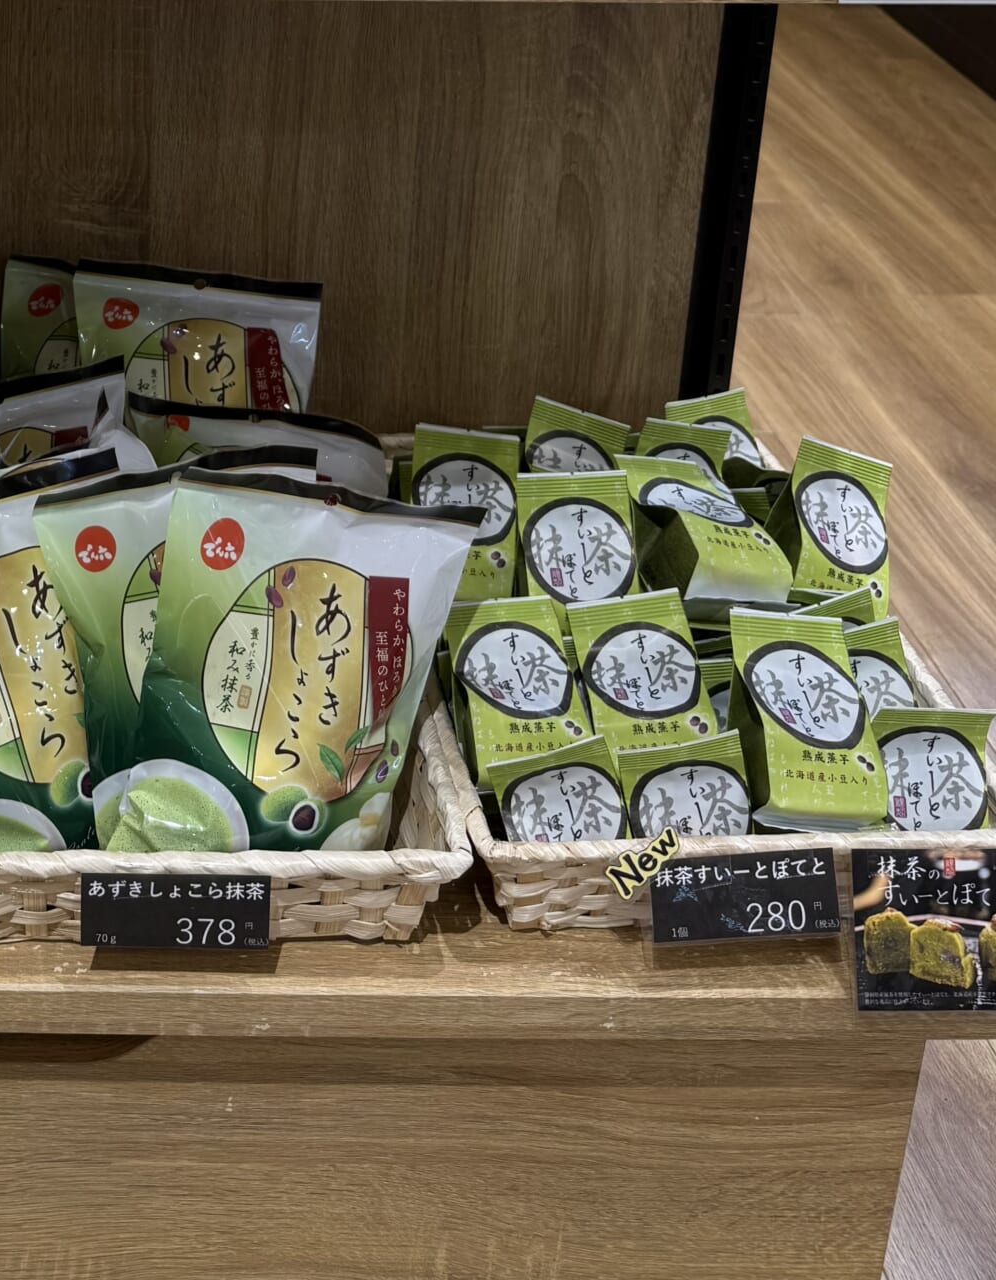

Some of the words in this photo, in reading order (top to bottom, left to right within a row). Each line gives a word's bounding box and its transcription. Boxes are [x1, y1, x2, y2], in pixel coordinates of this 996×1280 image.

[571, 507, 594, 586] すいーと
[315, 583, 352, 727] あずき
[502, 632, 535, 702] すいーと
[630, 632, 661, 700] すいーと
[274, 609, 309, 773] しょこら
[788, 653, 825, 730] すいーと
[923, 735, 943, 820] すいーと
[88, 879, 266, 901] あずきしょこら抹茶
[615, 830, 679, 896] New
[654, 857, 827, 888] 抹茶すいーとぽてと
[877, 855, 941, 881] 抹茶の
[878, 879, 992, 907] すいーとぽて
[175, 917, 236, 946] 378
[245, 922, 254, 930] 円
[671, 926, 689, 939] 1個
[745, 900, 806, 933] 280
[813, 901, 822, 911] 円
[814, 918, 841, 930] (税込)
